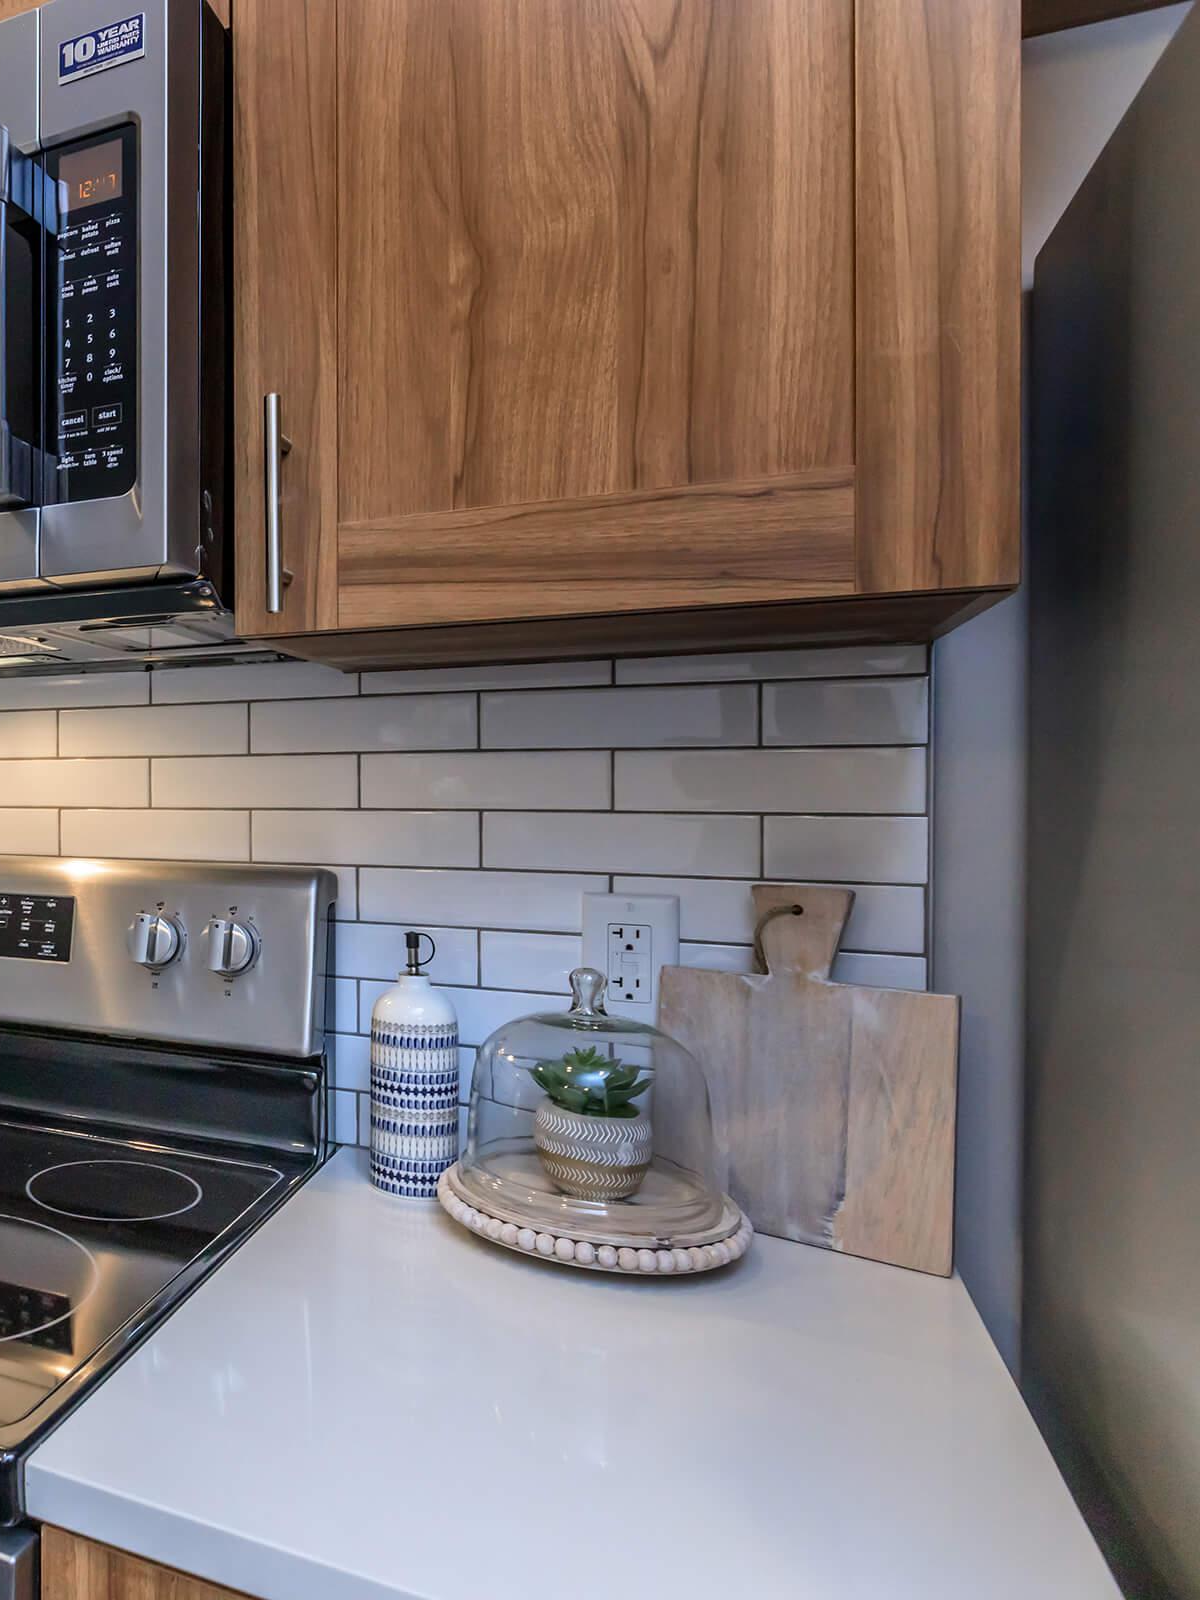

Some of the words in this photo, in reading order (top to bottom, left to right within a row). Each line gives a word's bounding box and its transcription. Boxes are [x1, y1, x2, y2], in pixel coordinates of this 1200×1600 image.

[62, 36, 96, 68] 10
[97, 19, 140, 41] YEAR
[97, 36, 140, 56] WARRANTY
[82, 223, 98, 232] baked
[106, 218, 120, 227] pizza
[57, 230, 78, 241] popcorn
[82, 231, 99, 240] potato
[65, 319, 71, 328] 1
[87, 314, 93, 323] 2
[109, 308, 116, 318] 3
[65, 339, 71, 348] 4
[87, 334, 93, 343] 5
[109, 329, 116, 338] 6
[65, 359, 71, 368] 7
[86, 353, 93, 362] 8
[109, 348, 116, 358] 9
[87, 372, 93, 381] 0
[103, 374, 124, 383] options
[61, 415, 84, 426] cancel
[98, 410, 116, 420] start
